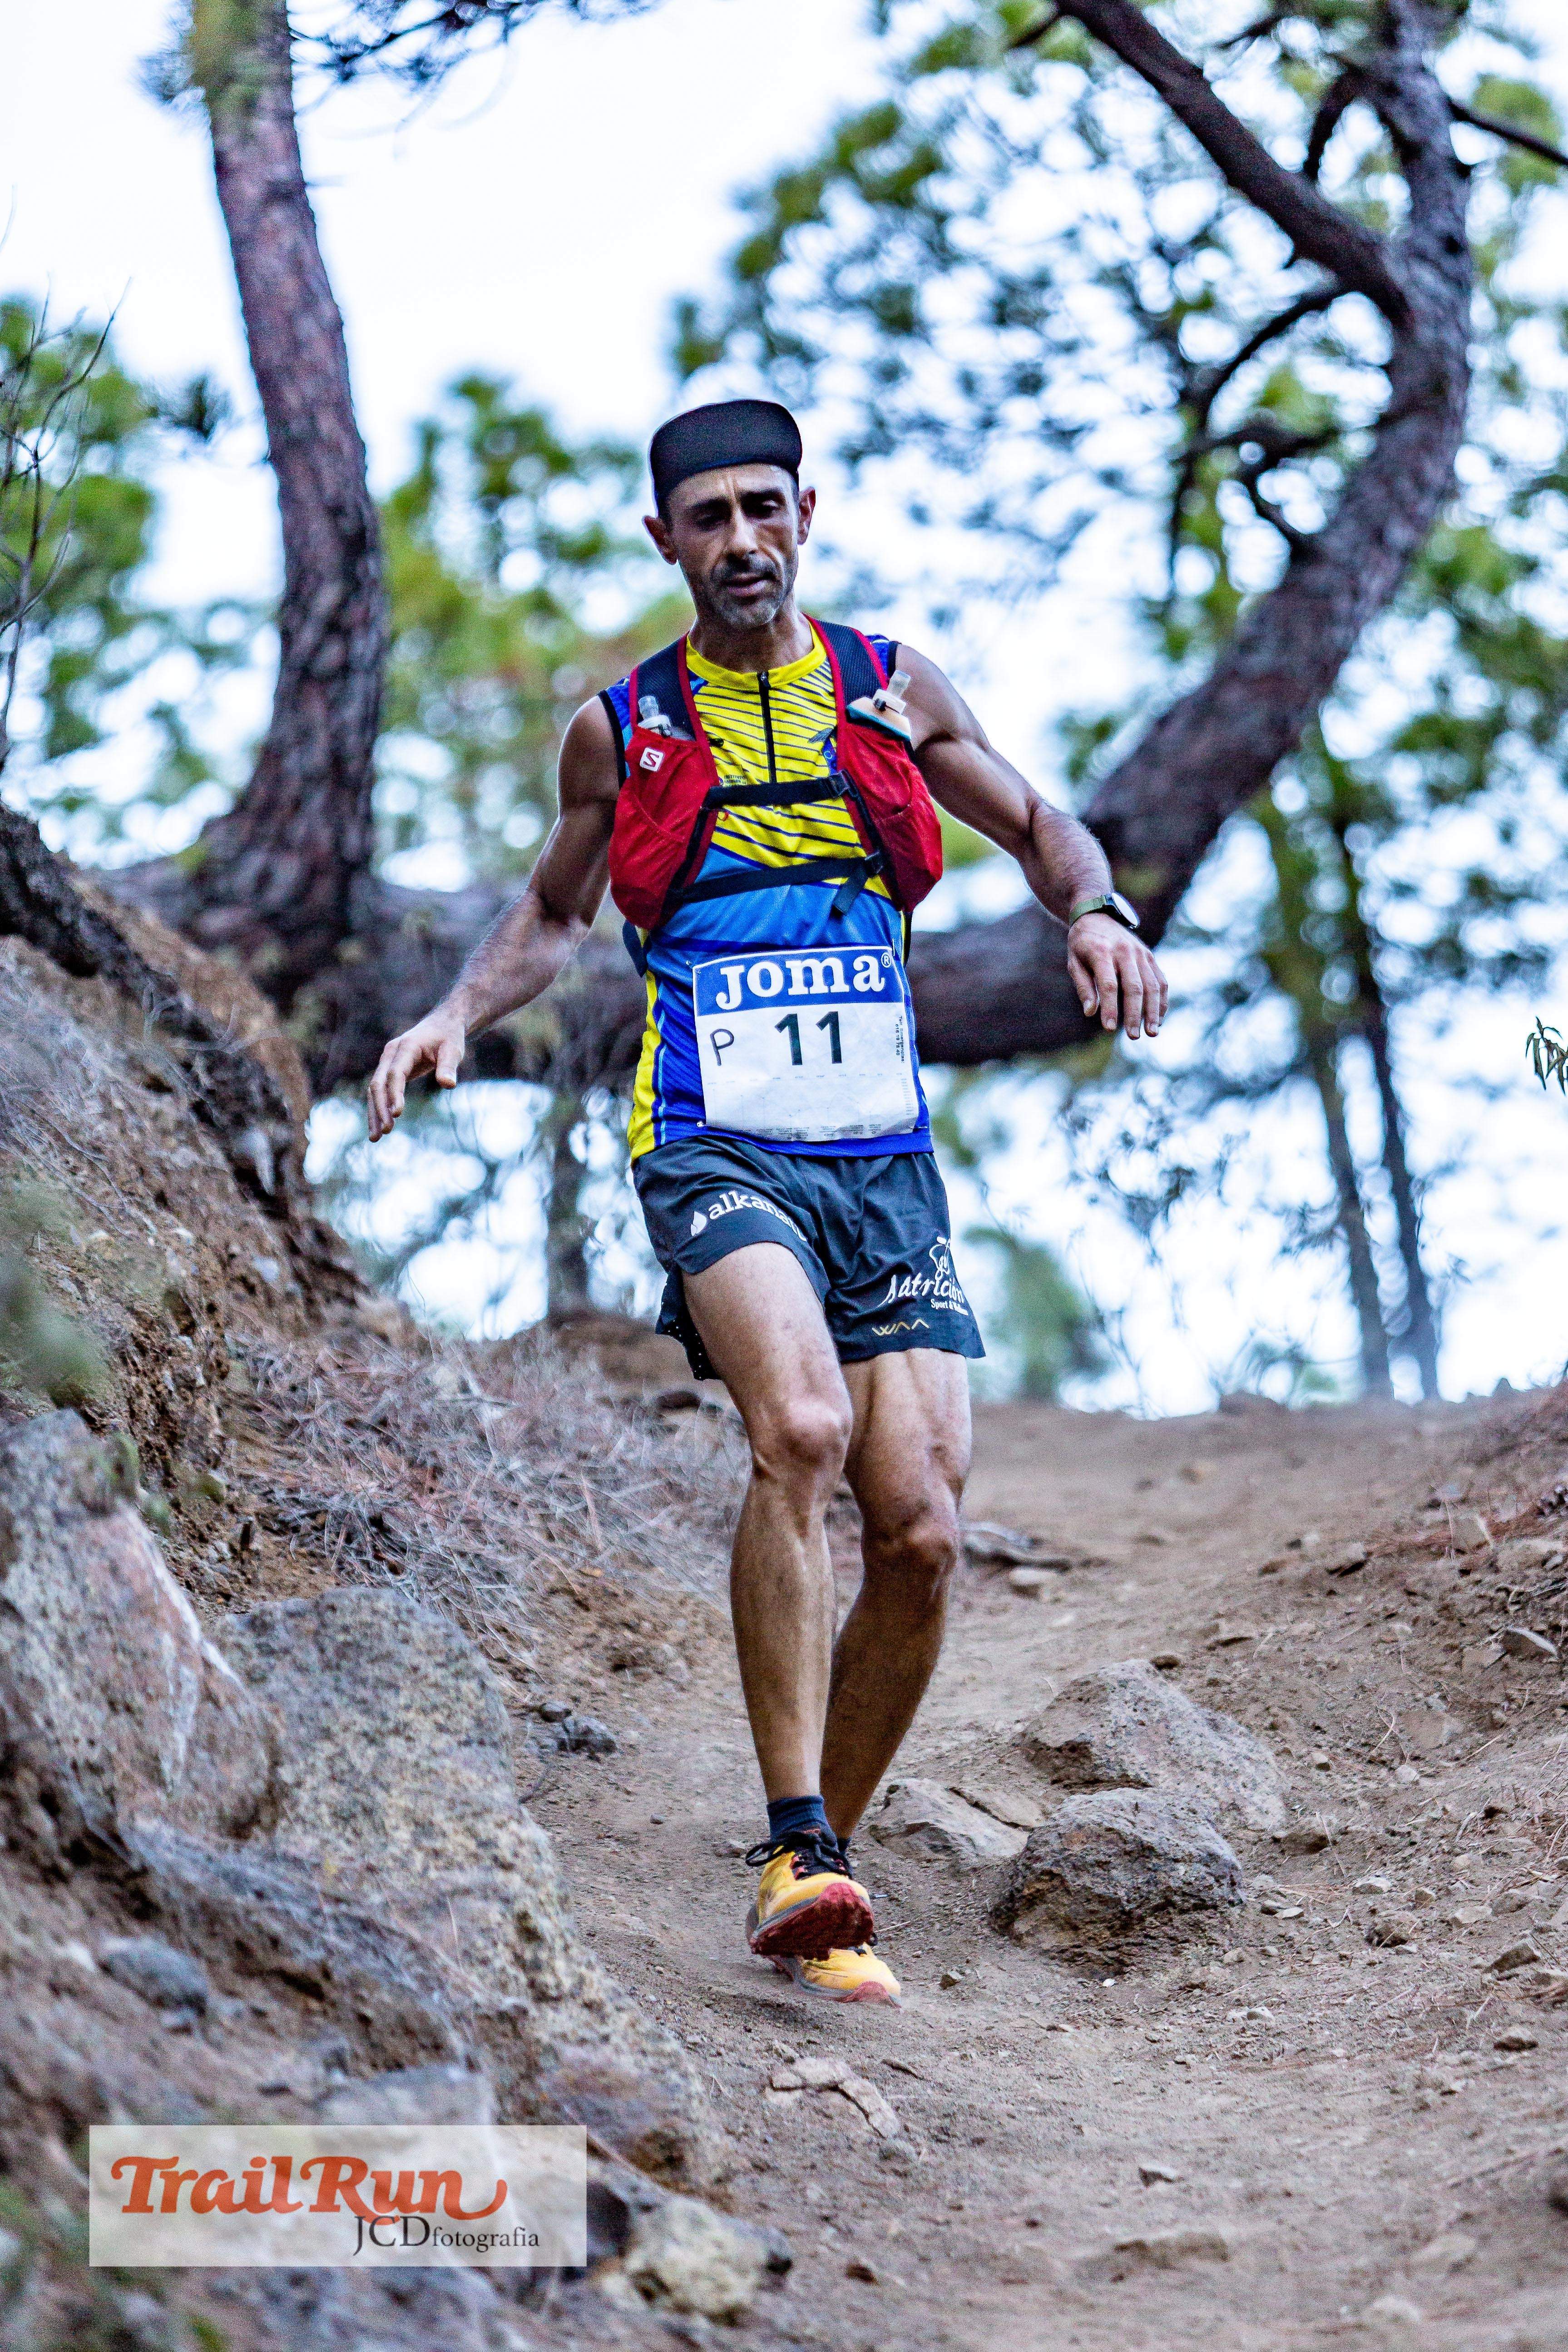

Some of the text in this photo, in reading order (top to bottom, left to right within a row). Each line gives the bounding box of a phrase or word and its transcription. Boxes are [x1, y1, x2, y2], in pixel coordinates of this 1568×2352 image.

[710, 1028, 735, 1067] P
[774, 1011, 842, 1066] 11
[930, 1298, 949, 1310] Sport
